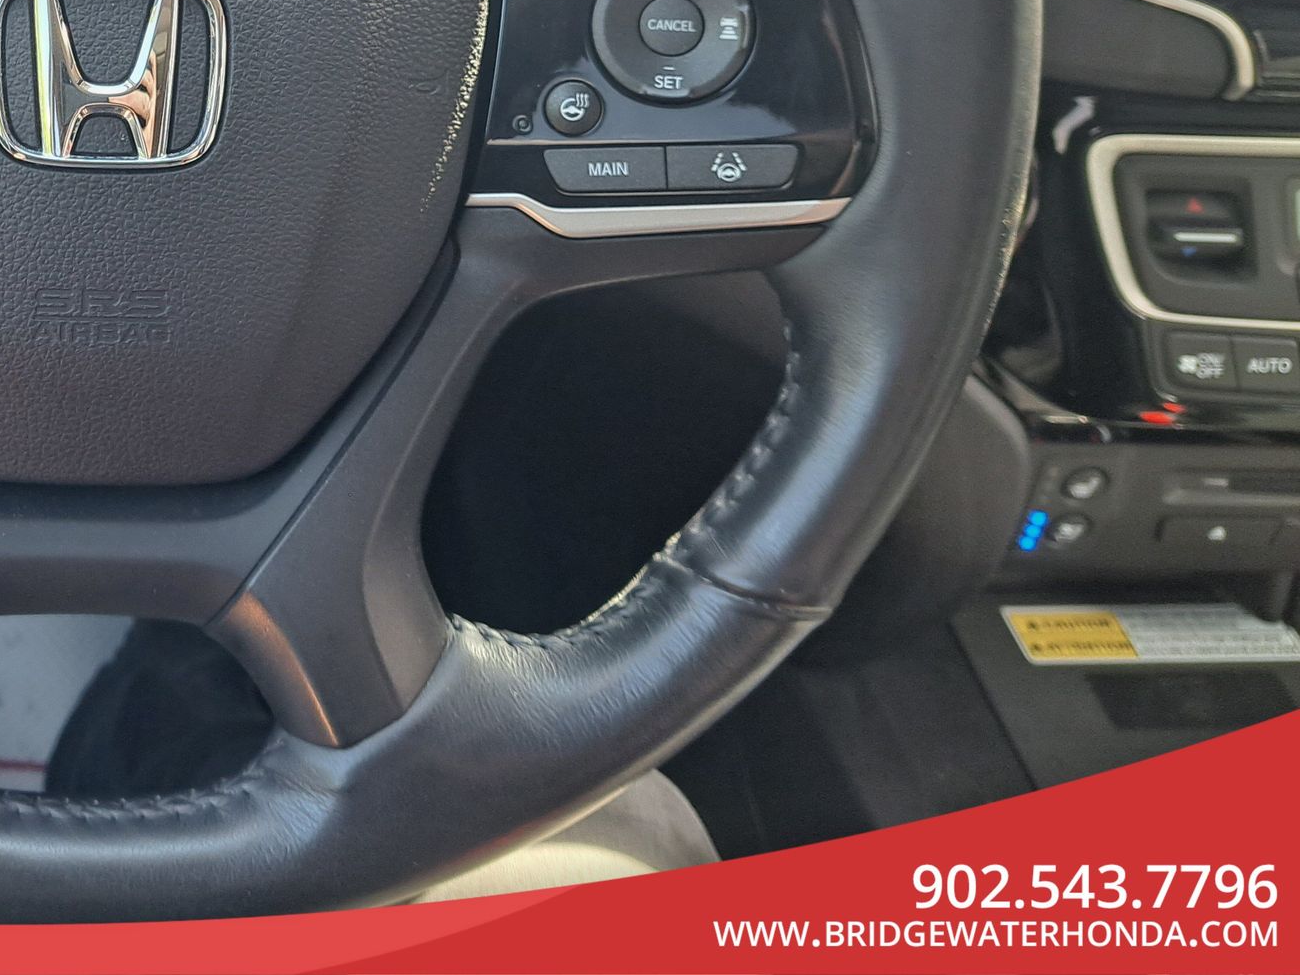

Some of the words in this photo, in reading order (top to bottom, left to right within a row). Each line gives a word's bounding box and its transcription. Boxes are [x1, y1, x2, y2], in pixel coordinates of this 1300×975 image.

[647, 18, 696, 33] CANCEL
[654, 75, 683, 90] SET
[588, 161, 629, 177] MAIN
[35, 288, 172, 318] SRS
[1247, 357, 1293, 374] AUTO
